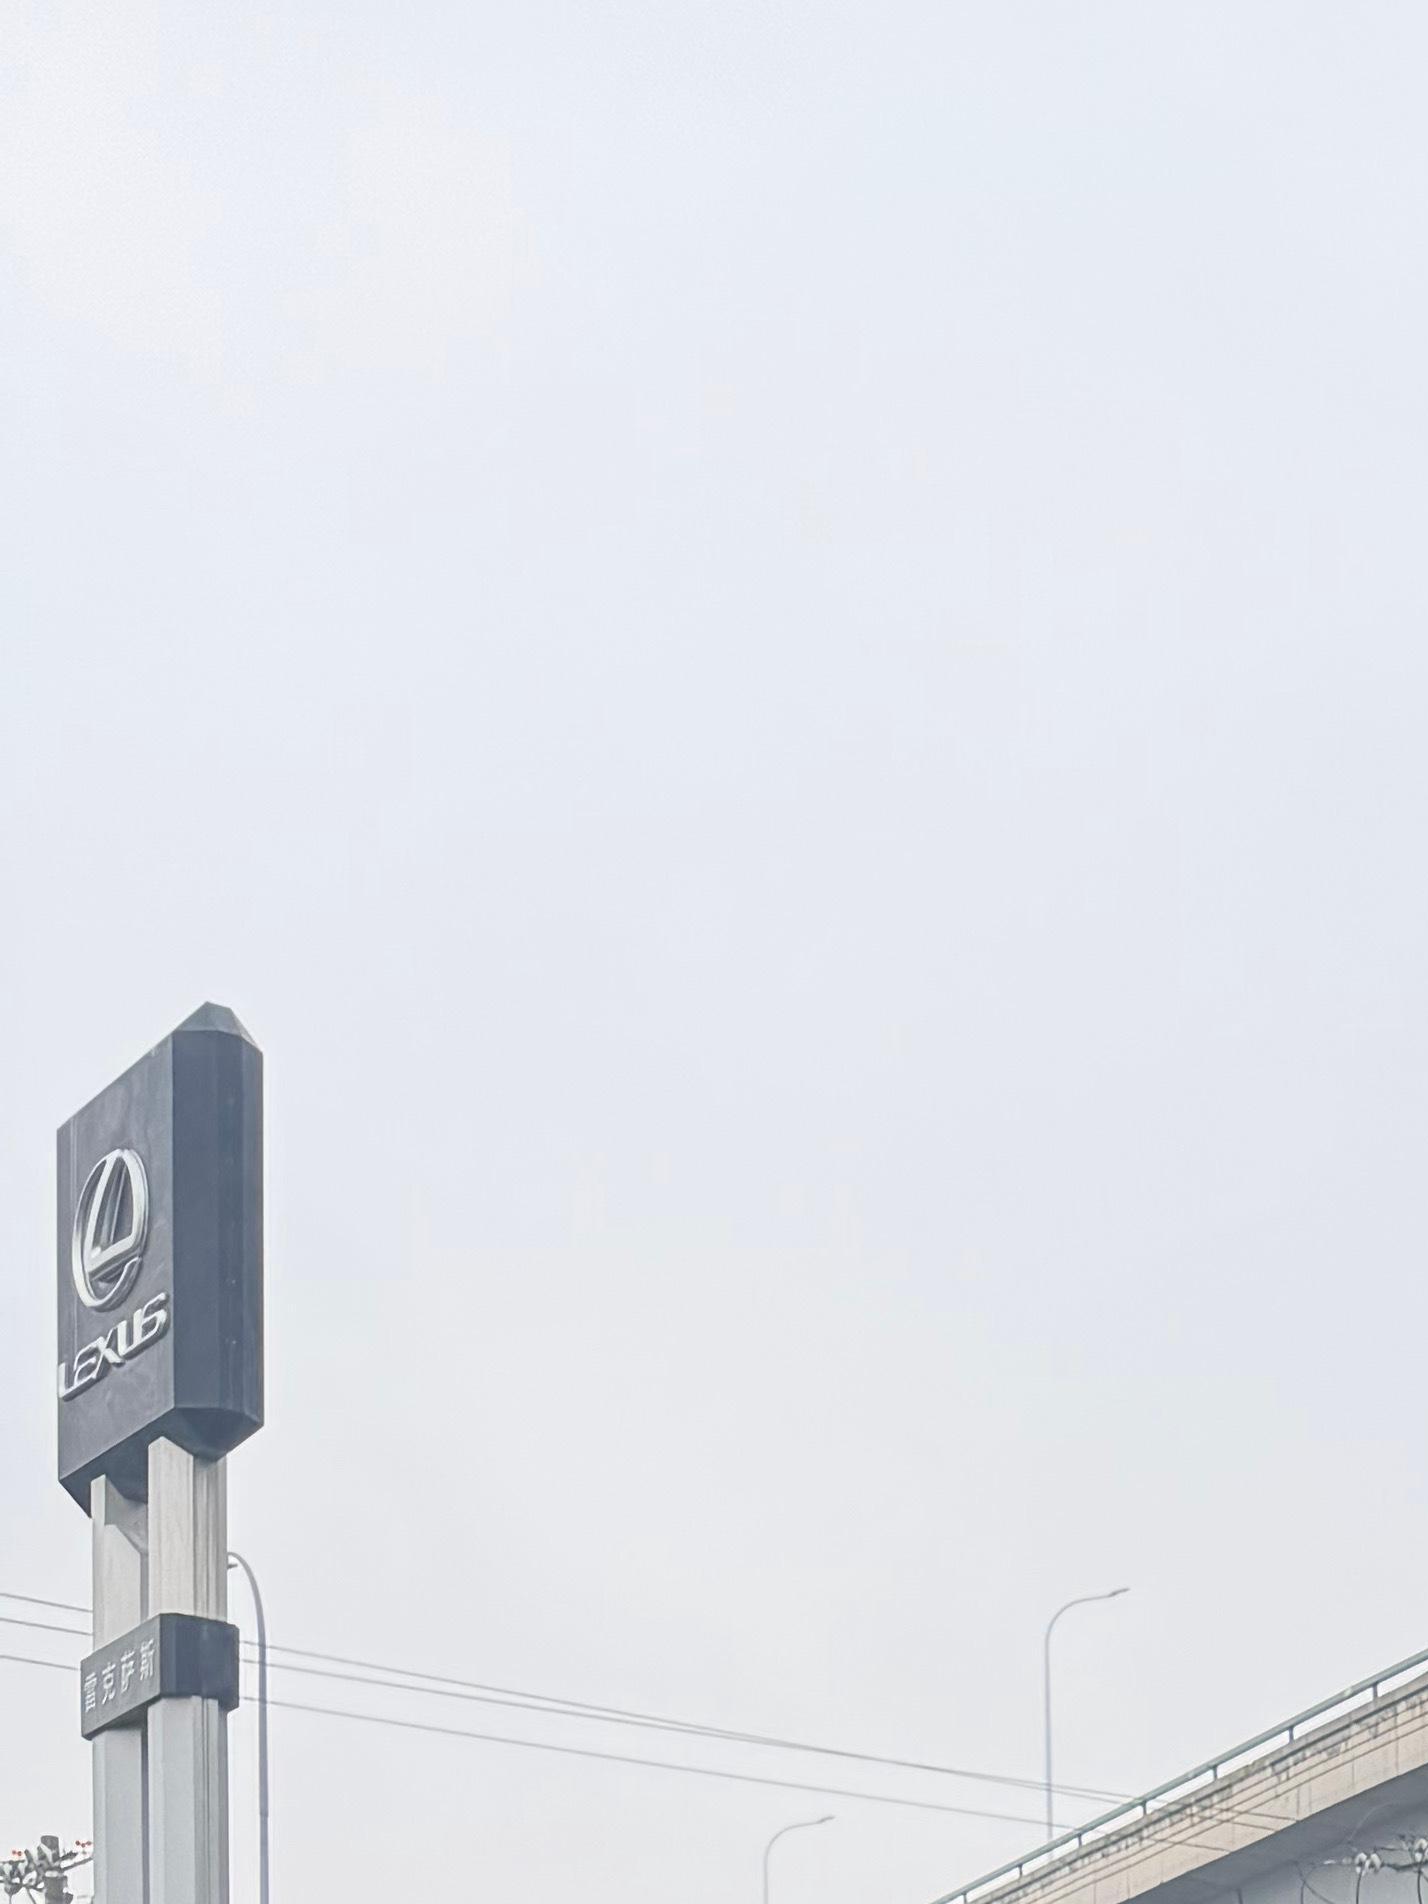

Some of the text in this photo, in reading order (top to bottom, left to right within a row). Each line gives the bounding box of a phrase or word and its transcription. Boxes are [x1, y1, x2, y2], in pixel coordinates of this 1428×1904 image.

[58, 1292, 166, 1399] LEXUS
[84, 1639, 155, 1712] 雷克萨斯
